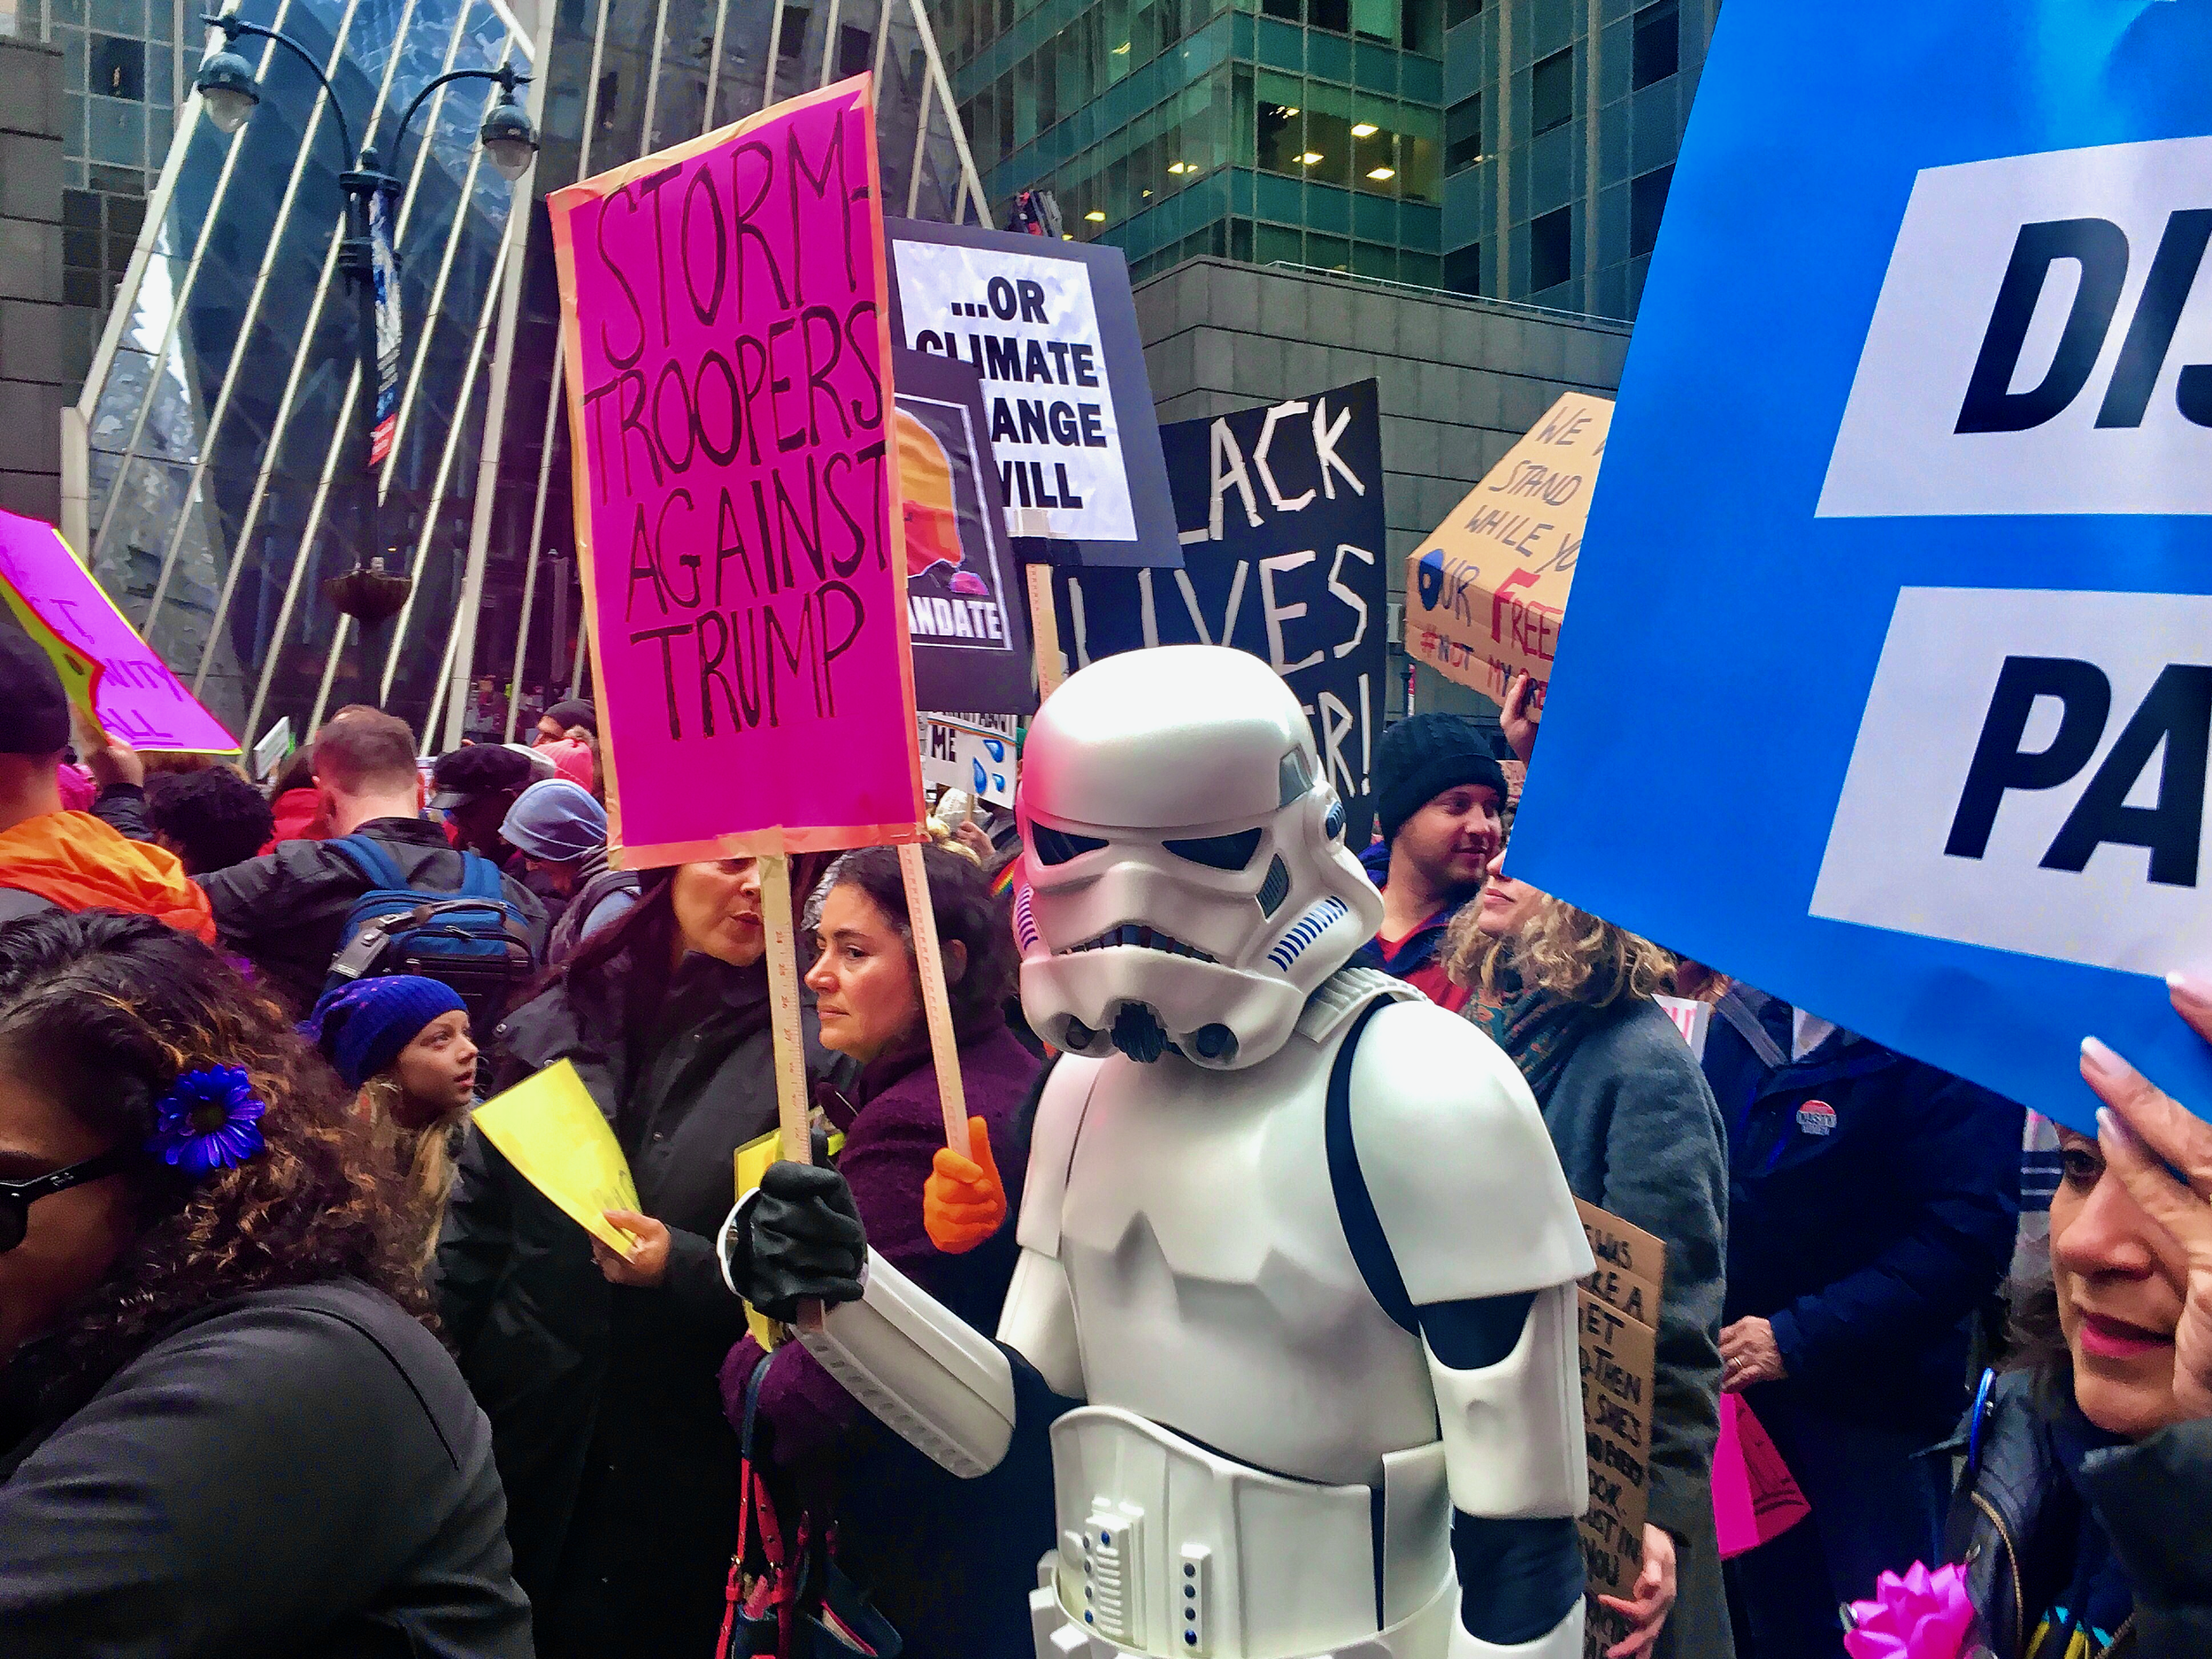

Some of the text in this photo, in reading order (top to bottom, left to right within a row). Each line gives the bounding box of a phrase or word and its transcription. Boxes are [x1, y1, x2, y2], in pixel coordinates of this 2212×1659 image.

[597, 107, 872, 370] STORM-
[950, 276, 1049, 325] ...OR
[1953, 207, 2212, 434] DI
[583, 301, 883, 506] TROOPERS
[990, 397, 1108, 449] ANGE
[1536, 406, 1593, 445] WE
[1178, 396, 1365, 545] ACK
[1488, 459, 1582, 507] STAND
[626, 439, 887, 623] AGAINST
[1463, 504, 1555, 557] WHILE
[630, 580, 864, 741] TRUMP
[1418, 548, 1564, 662] OUR FREE
[931, 724, 956, 764] ME
